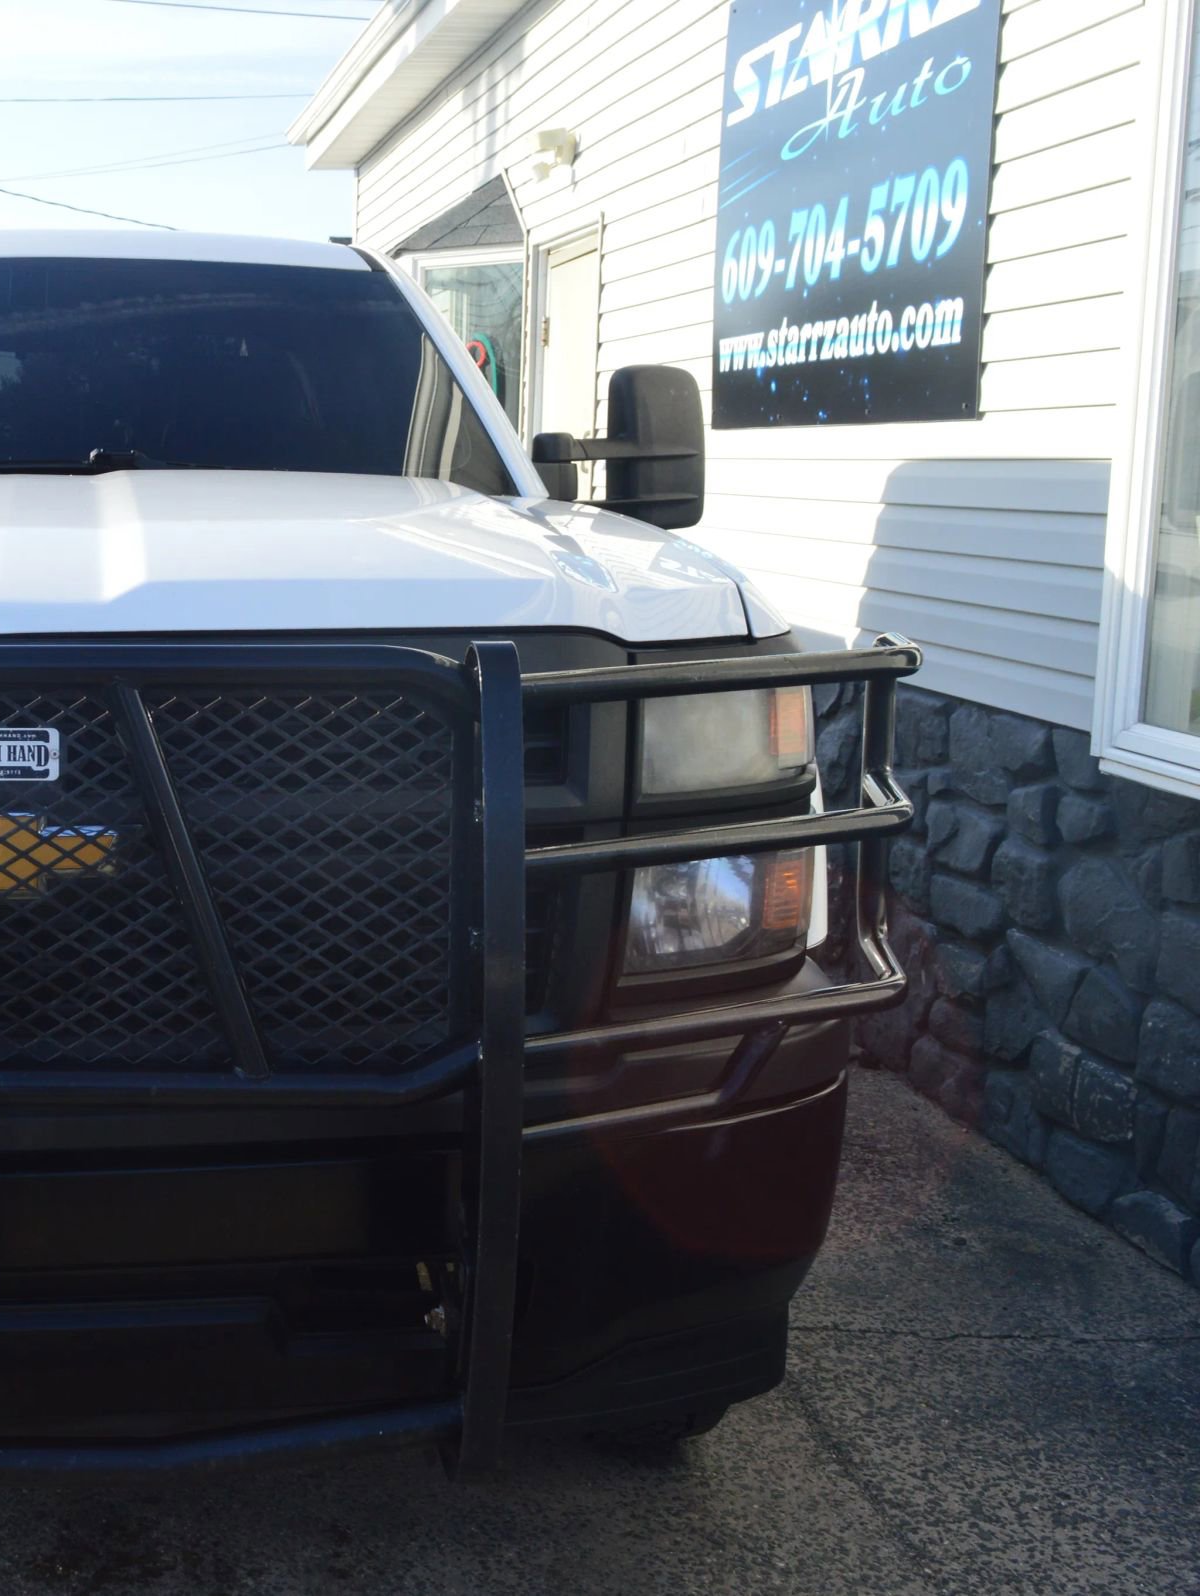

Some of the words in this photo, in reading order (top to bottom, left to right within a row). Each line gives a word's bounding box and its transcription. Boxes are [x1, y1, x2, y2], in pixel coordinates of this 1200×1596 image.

[727, 0, 983, 127] STARR
[780, 55, 972, 161] Auto
[720, 156, 969, 304] 609-704-5709
[718, 296, 965, 373] www.starrzauto.com
[6, 744, 50, 767] HAND
